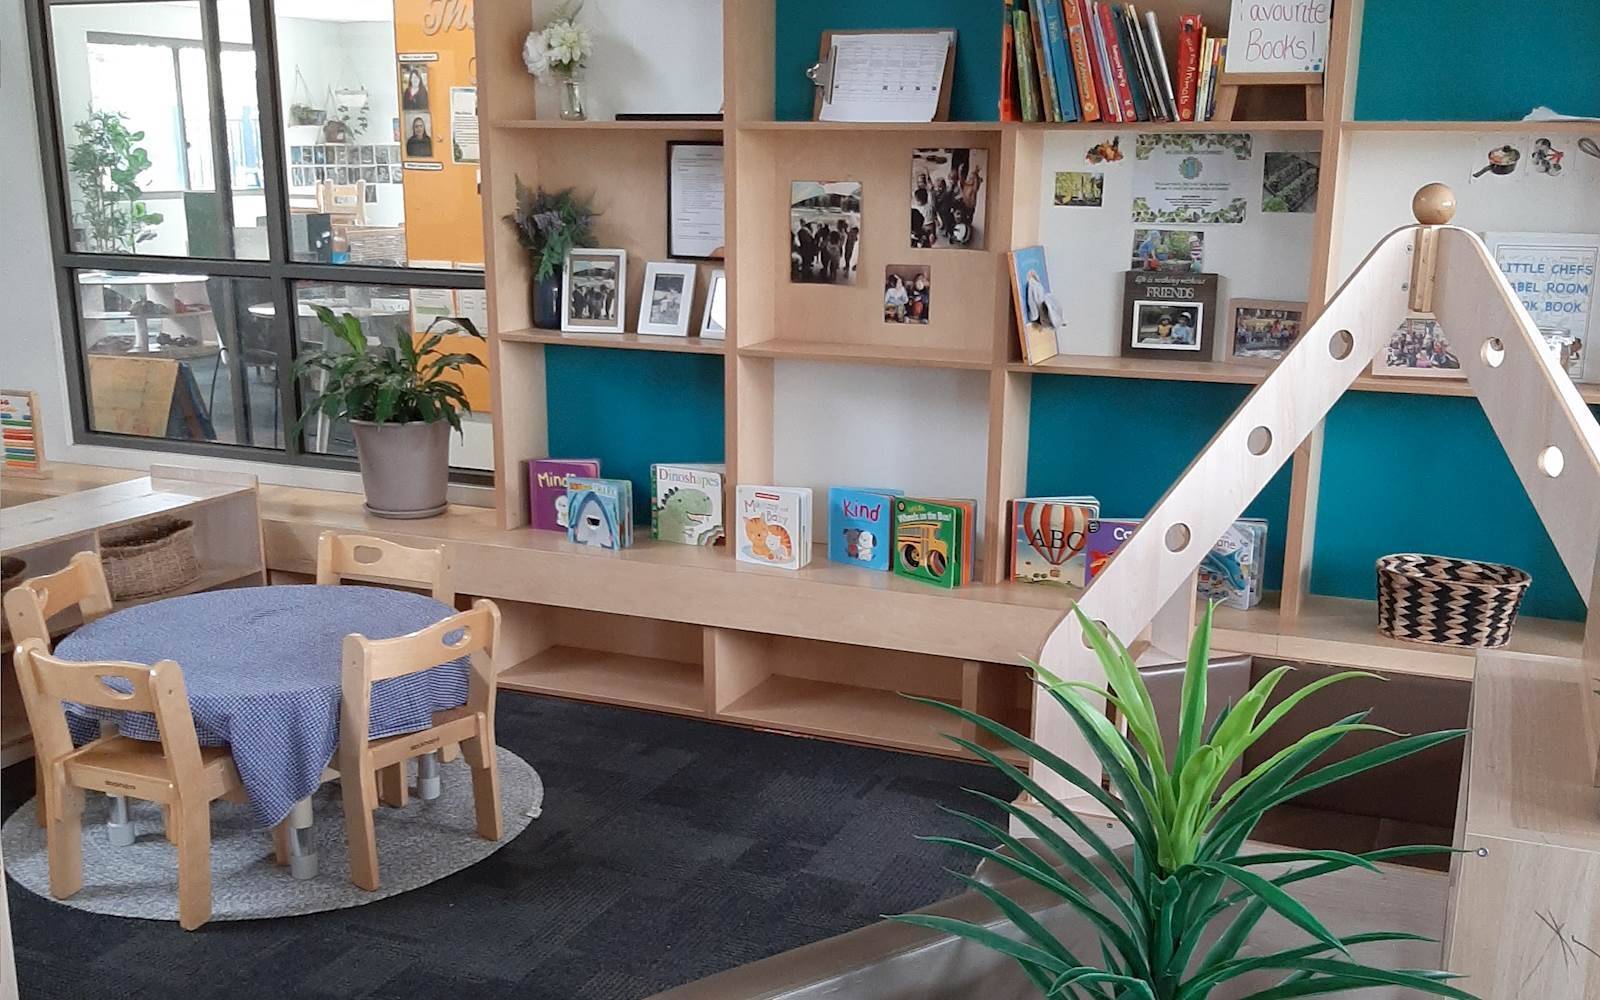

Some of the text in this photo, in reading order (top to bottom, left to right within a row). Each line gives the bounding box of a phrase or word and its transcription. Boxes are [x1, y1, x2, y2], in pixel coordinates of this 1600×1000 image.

[1245, 27, 1316, 62] Books!
[1180, 66, 1196, 105] Animals
[1500, 263, 1593, 276] LITTLE CHEFS
[1146, 287, 1194, 298] FRIENDS
[1547, 283, 1588, 294] ROOM
[1545, 302, 1581, 312] BOOK
[843, 499, 881, 522] Kind
[1028, 528, 1086, 552] ABC
